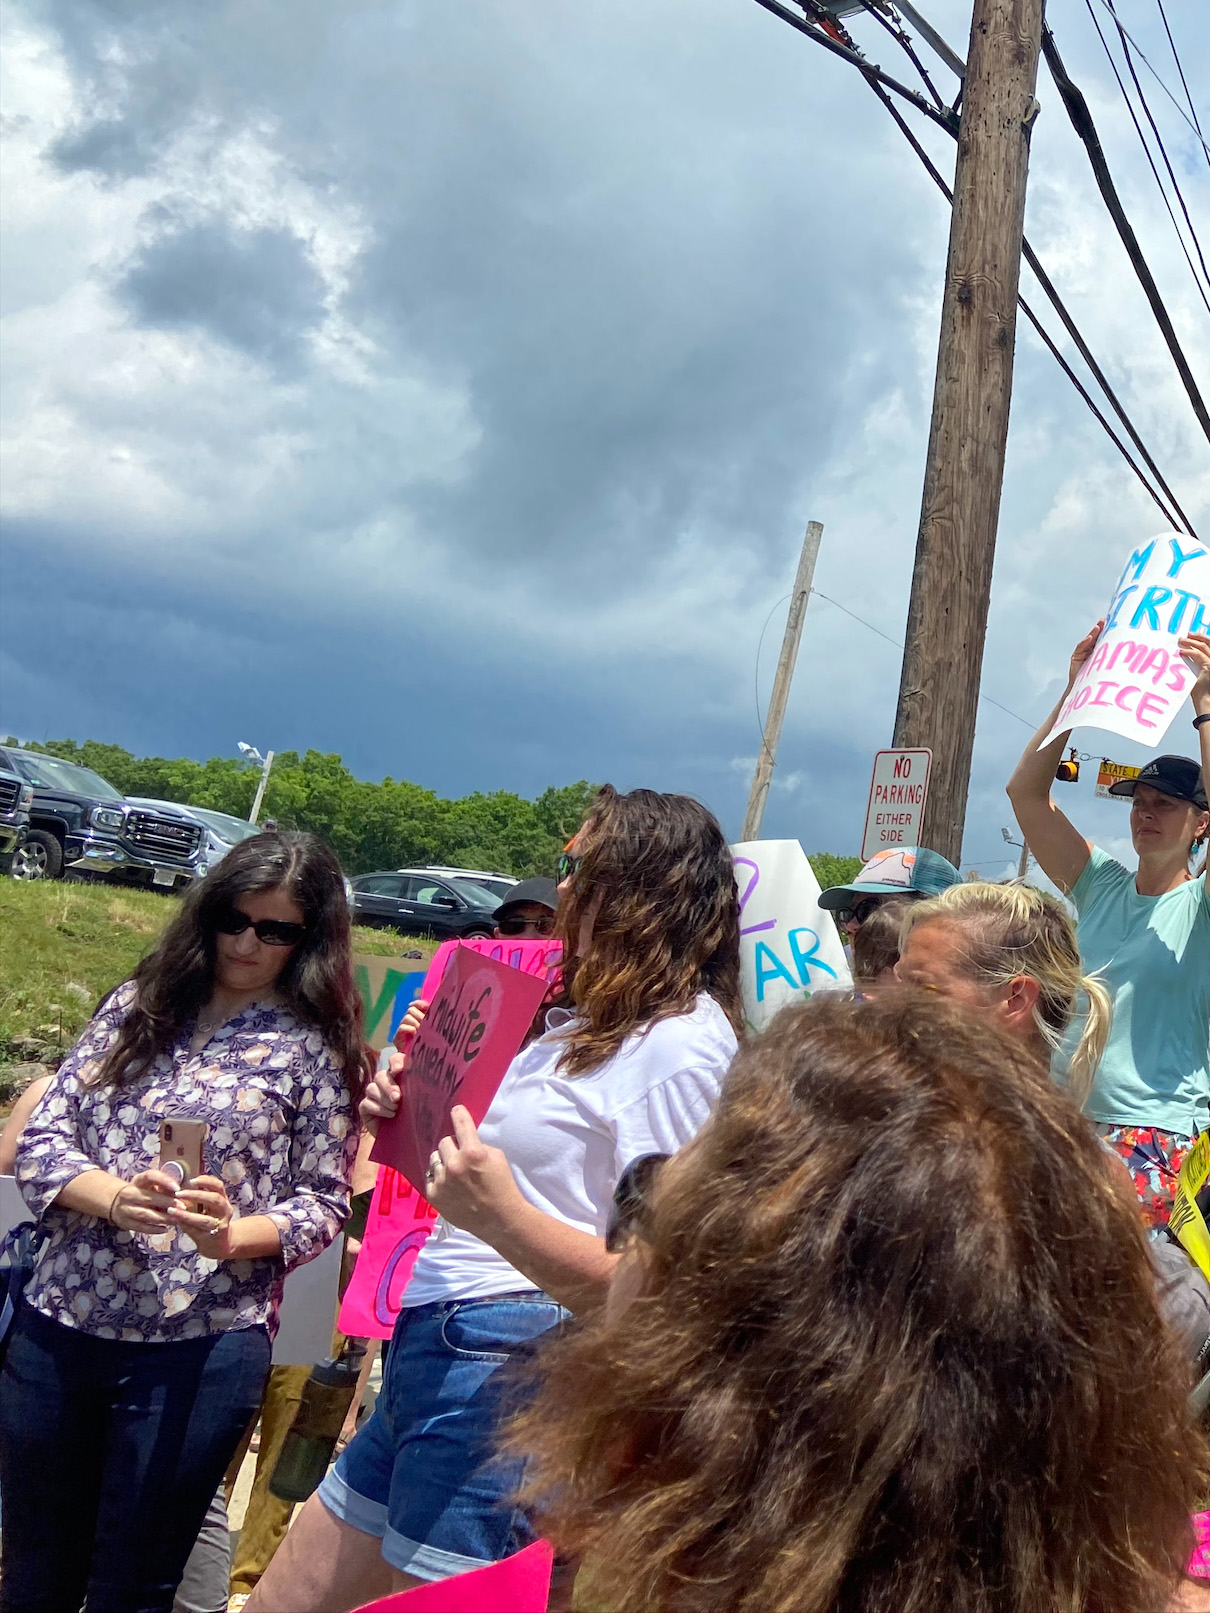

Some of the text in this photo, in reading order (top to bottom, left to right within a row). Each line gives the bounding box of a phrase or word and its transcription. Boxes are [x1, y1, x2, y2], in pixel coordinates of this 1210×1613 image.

[893, 758, 912, 779] NO
[1102, 762, 1128, 776] STATE
[874, 784, 923, 805] PARKING
[875, 813, 912, 826] EITHER
[879, 829, 904, 842] SIDE
